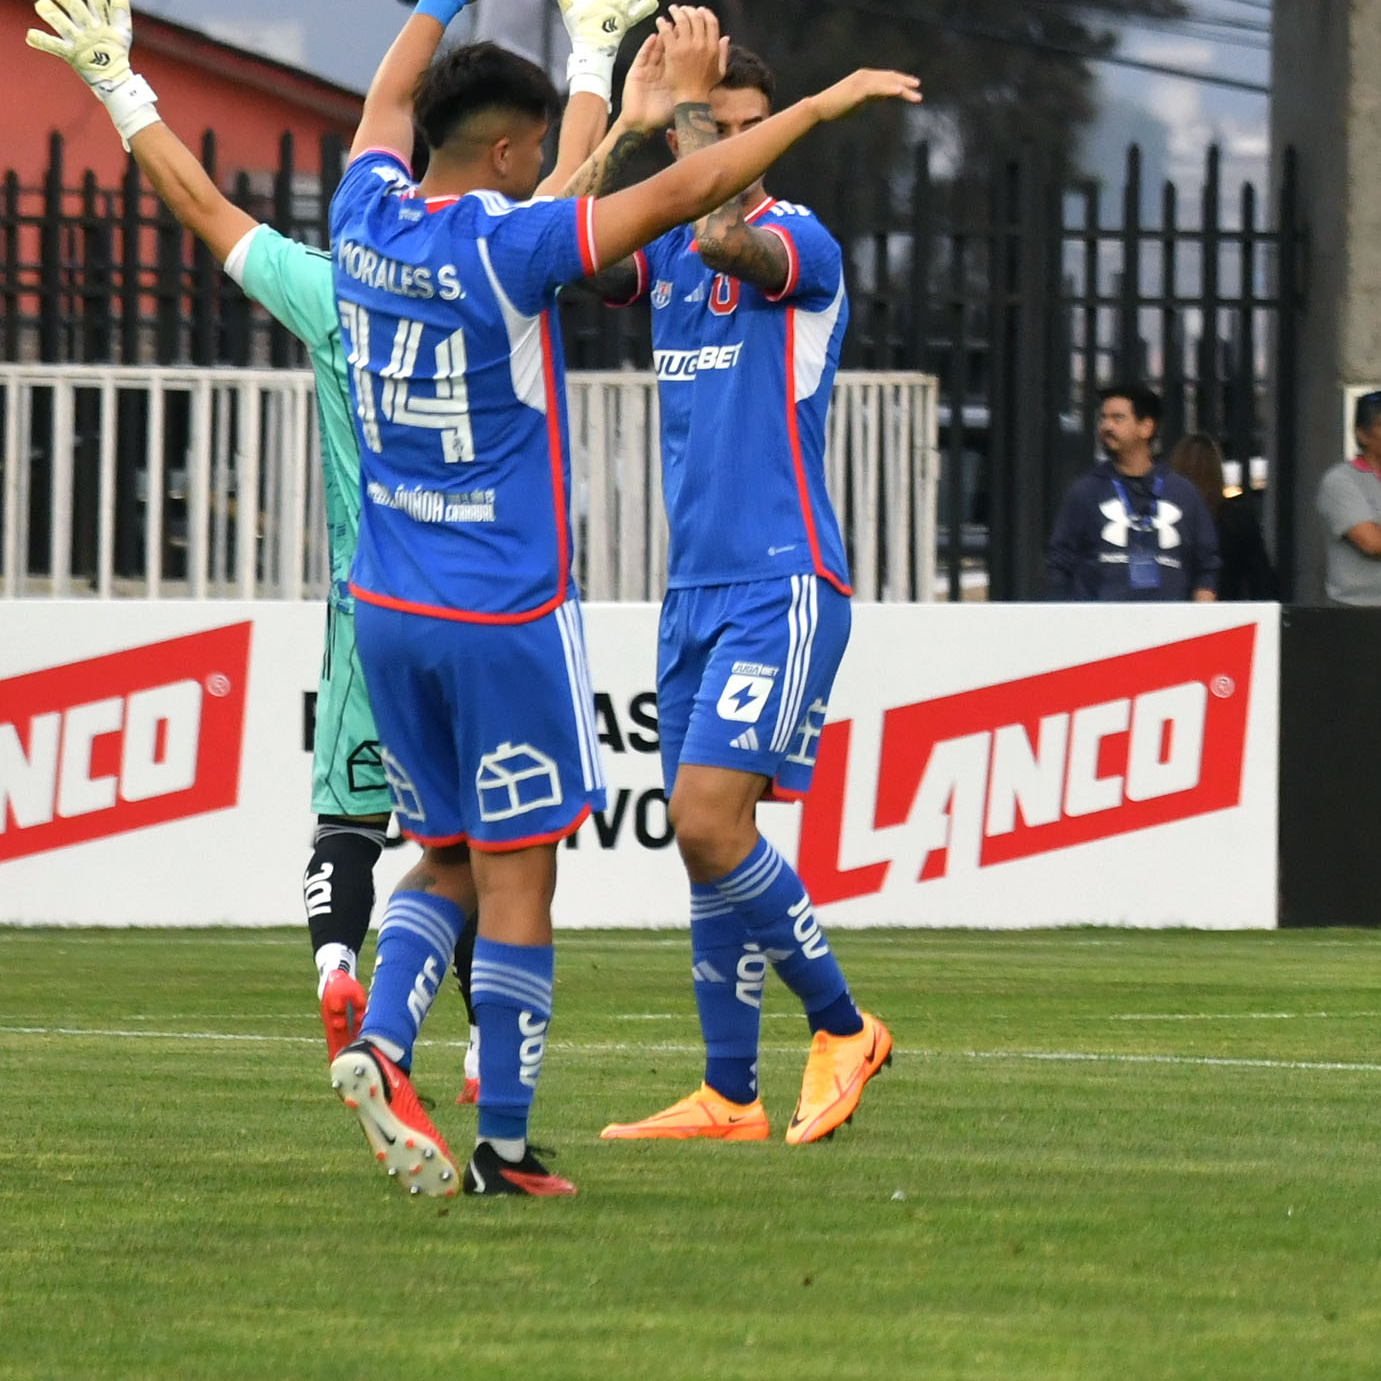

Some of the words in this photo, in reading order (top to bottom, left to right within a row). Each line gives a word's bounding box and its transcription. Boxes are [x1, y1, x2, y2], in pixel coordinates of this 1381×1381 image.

[338, 236, 434, 300] MORALES
[338, 300, 475, 464] 14
[836, 680, 1208, 884] LANCO
